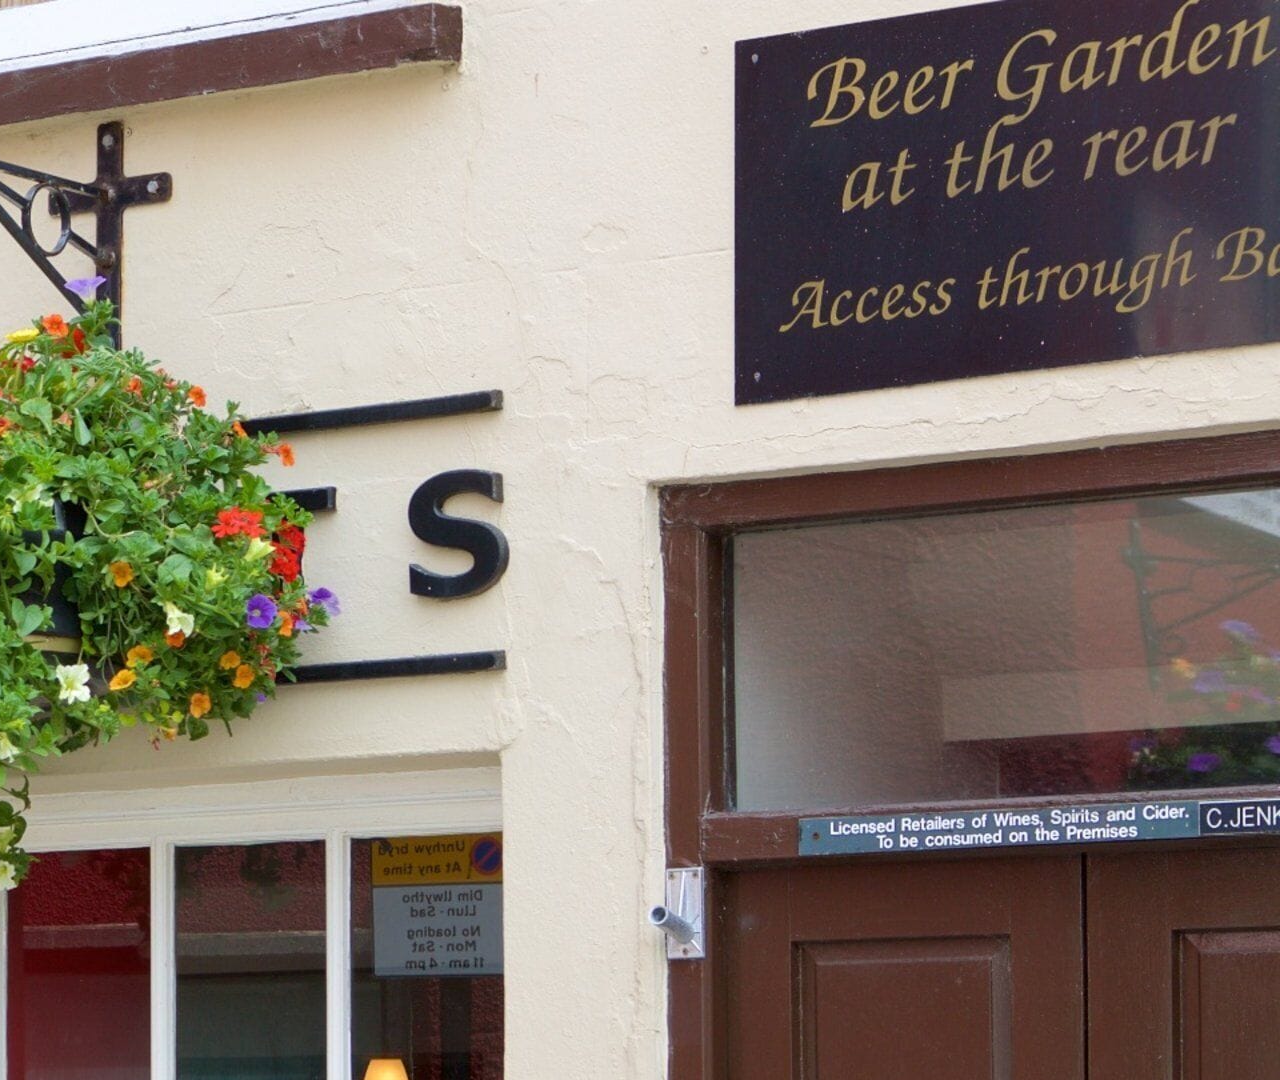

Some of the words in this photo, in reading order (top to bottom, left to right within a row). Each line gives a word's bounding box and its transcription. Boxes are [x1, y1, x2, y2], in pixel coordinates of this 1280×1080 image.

[806, 55, 974, 128] Beer
[996, 0, 1278, 120] Garden
[842, 148, 915, 212] at
[944, 114, 1054, 199] the
[1083, 113, 1238, 181] rear
[778, 276, 957, 333] Access
[977, 226, 1198, 313] through
[830, 818, 895, 836] Licensed
[901, 815, 965, 832] Retailers
[972, 813, 987, 828] of
[993, 812, 1044, 827] Wines,
[1050, 808, 1100, 826] Spirits
[1106, 807, 1136, 822] and
[1142, 805, 1189, 820] Cider.
[876, 835, 893, 849] To
[900, 834, 919, 848] be
[925, 829, 1003, 847] consumed
[1009, 831, 1028, 843] on
[1035, 827, 1060, 841] the
[1066, 824, 1138, 840] Premises
